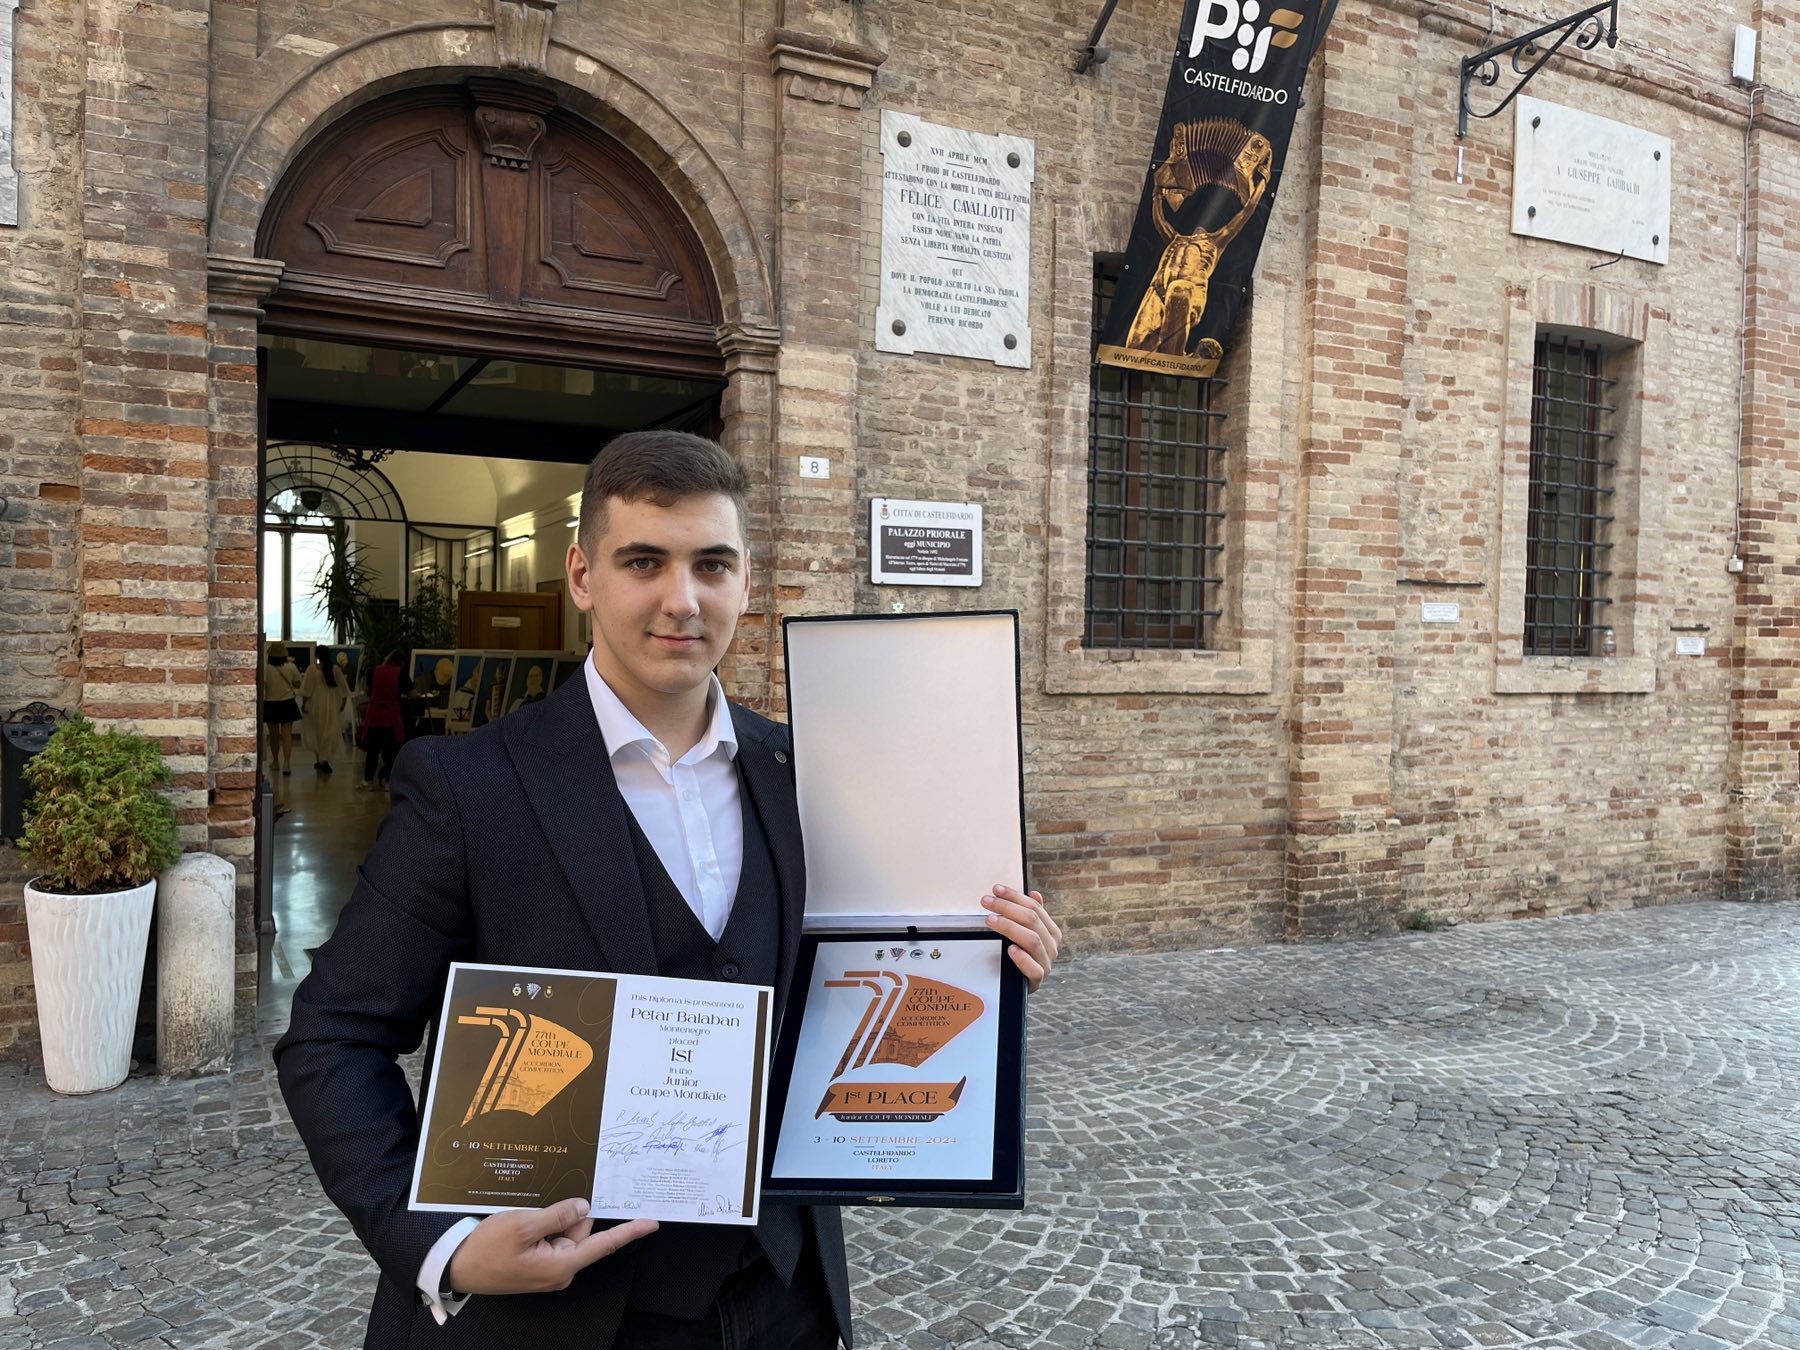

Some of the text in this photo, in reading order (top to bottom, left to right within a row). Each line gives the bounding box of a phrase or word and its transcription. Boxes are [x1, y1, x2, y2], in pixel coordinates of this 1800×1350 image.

[1184, 67, 1288, 105] CASTELFIDARDO
[930, 147, 988, 166] XVII APRILE MCM
[922, 165, 940, 174] PRODI
[942, 168, 949, 176] DI
[952, 171, 1001, 186] CASTELFIDARDO
[1567, 166, 1601, 184] GIUSEPPE
[1607, 176, 1640, 195] GARIBALDI
[926, 178, 938, 188] CON
[950, 183, 968, 194] MORTE
[994, 190, 1011, 200] DELLA
[1013, 194, 1030, 204] PATRIA
[900, 188, 1015, 222] FELICE CAVALLOTTI
[912, 212, 925, 220] CON
[938, 216, 950, 226] VITA
[954, 219, 974, 230] INTERA
[912, 224, 1002, 246] ESSER NOME VANO LA PATRIA
[900, 236, 920, 246] SENZA
[982, 249, 1012, 260] GIUSTIZIA
[952, 268, 963, 278] QUI
[890, 272, 906, 280] DOVE
[920, 276, 942, 286] POPOLO
[984, 285, 996, 294] SUA
[998, 288, 1019, 298] PAROLA
[903, 286, 1008, 308] LA DEMOCRAZIA CASTELFIDARDESE
[920, 301, 940, 312] VOLLE
[950, 306, 960, 314] LUI
[963, 308, 992, 318] DEDICATO
[928, 315, 984, 330] PERENNE RICORDO
[810, 461, 819, 474] 8
[922, 510, 974, 520] CASTELFIDARDO
[888, 528, 966, 540] PALAZZO PRIORALE
[904, 540, 951, 548] oggi MUNICIPIO
[649, 995, 682, 1005] Diploma
[692, 1000, 735, 1009] presented
[906, 1003, 972, 1012] MONDIALE
[631, 1007, 740, 1027] Petar Balaban
[535, 1030, 556, 1040] 77th
[660, 1024, 711, 1036] Montenegro
[532, 1040, 569, 1049] COUPE
[669, 1038, 699, 1046] placed
[528, 1048, 583, 1058] MONDIALE
[662, 1076, 702, 1087] Junior
[630, 1086, 727, 1102] Coupe Mondiale
[866, 1090, 938, 1104] PLACE
[468, 1141, 480, 1149] 10
[482, 1142, 540, 1152] SETTEMBRE
[543, 1145, 568, 1154] 2024
[483, 1162, 534, 1170] CASTELFIDARDO
